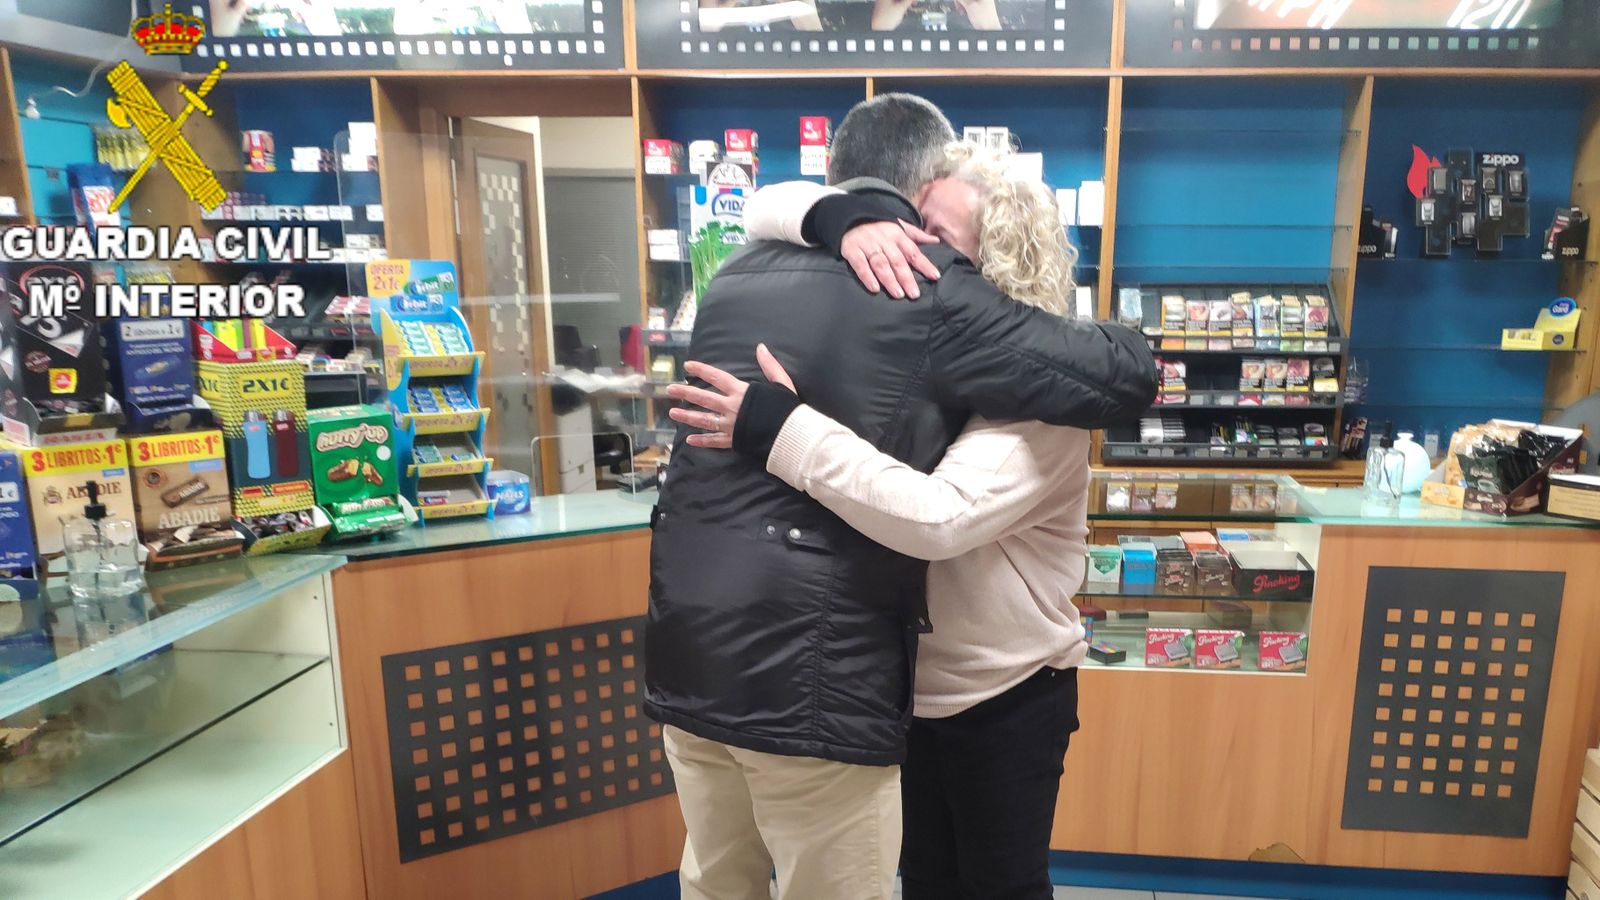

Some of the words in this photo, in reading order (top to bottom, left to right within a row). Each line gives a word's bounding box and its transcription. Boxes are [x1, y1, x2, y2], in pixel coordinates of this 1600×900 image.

[1482, 153, 1520, 166] zippo
[370, 264, 404, 276] OFERTA
[137, 441, 151, 462] 3
[151, 438, 201, 458] LIBRITOS
[31, 450, 46, 472] 3
[46, 448, 102, 469] LIBRITOS
[66, 481, 122, 499] ABDIE
[159, 506, 220, 530] ABADIE
[1252, 574, 1300, 593] Smoking
